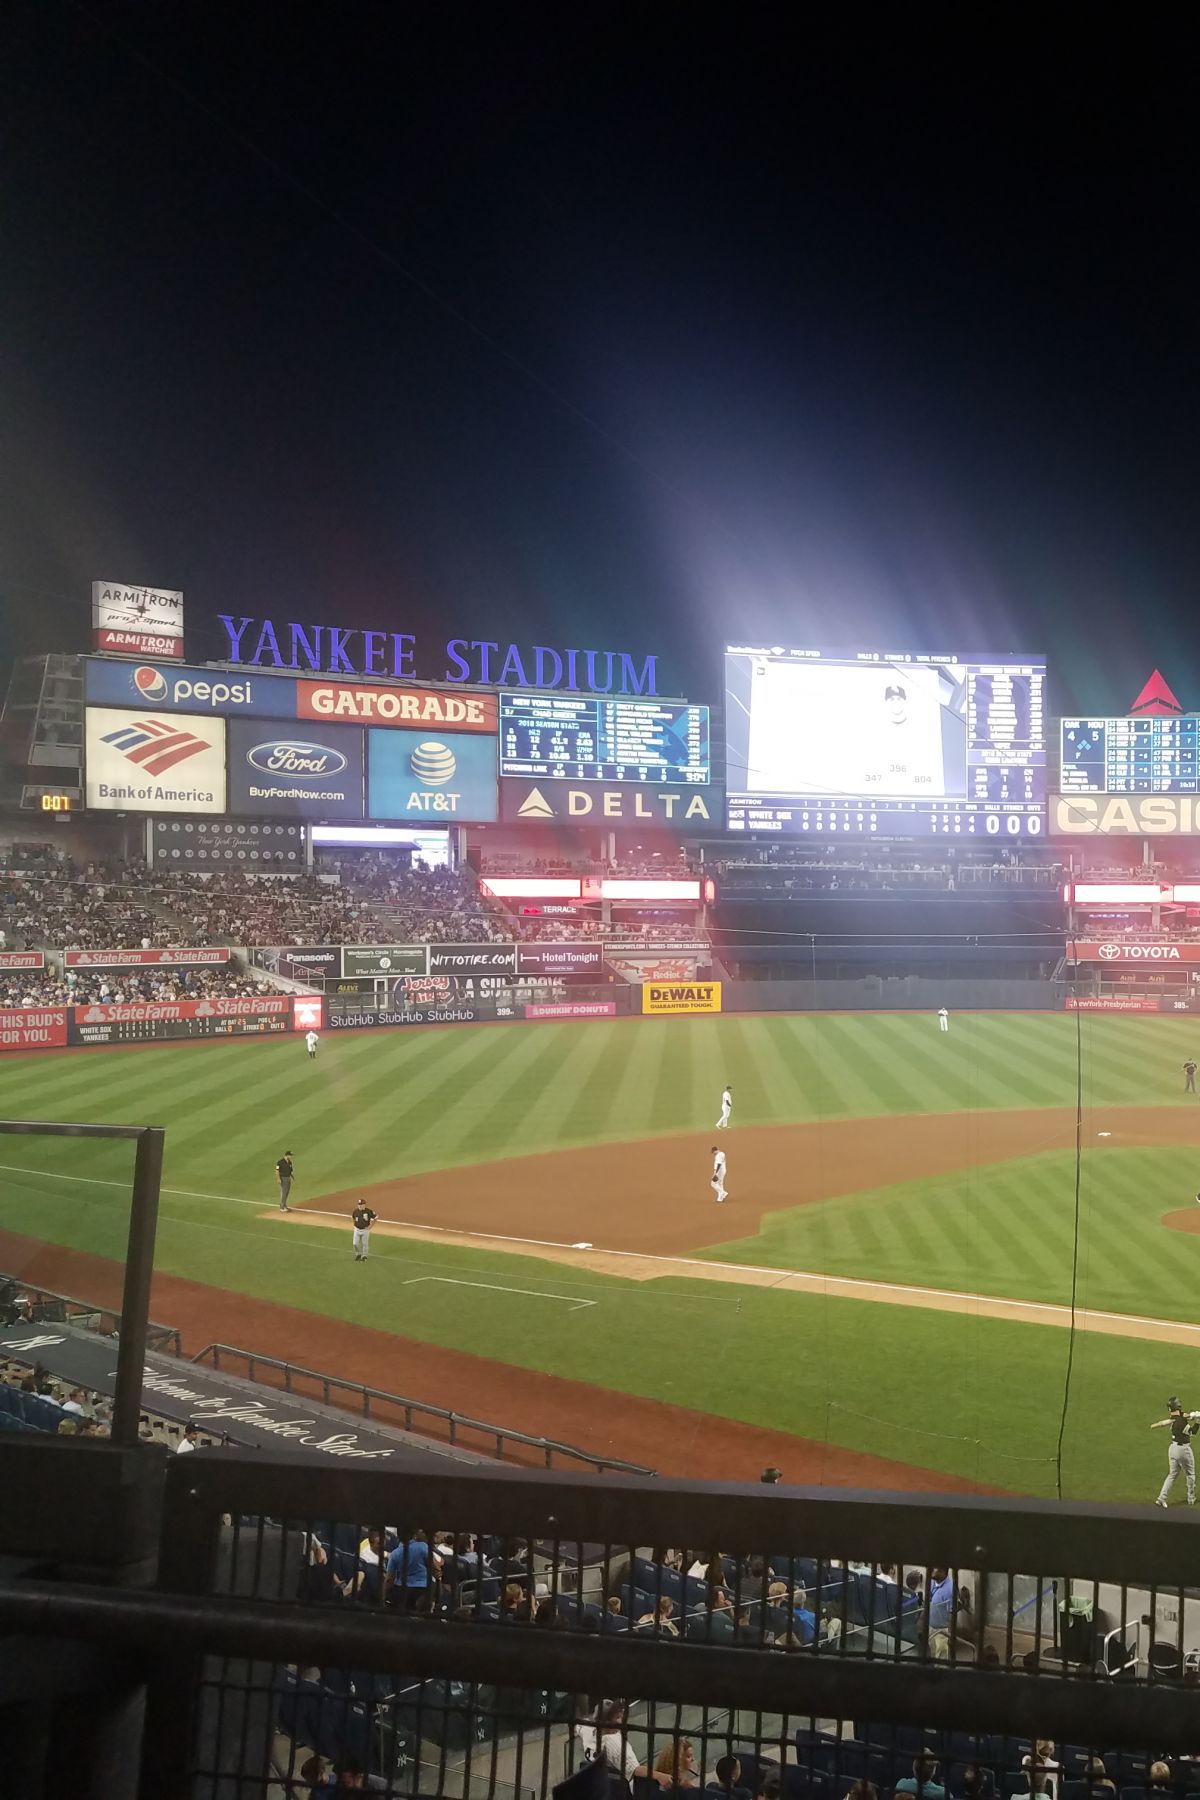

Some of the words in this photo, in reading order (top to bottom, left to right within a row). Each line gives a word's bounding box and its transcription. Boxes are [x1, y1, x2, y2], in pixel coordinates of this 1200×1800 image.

[103, 589, 179, 608] ARMITRON
[106, 633, 175, 648] ARMITRON
[140, 645, 174, 655] WATCHES
[217, 614, 416, 678] YANKEE
[446, 639, 659, 697] STADIUM
[174, 680, 252, 706] pepsi
[311, 689, 485, 724] GATORADE
[1067, 731, 1076, 741] 4
[1092, 731, 1099, 741] 5
[267, 746, 327, 773] Ford
[99, 784, 136, 800] Bank
[137, 785, 153, 800] of
[155, 785, 214, 802] America
[249, 787, 345, 800] BuyFordNow.com
[406, 792, 461, 812] AT&T
[568, 790, 711, 819] DELTA
[986, 815, 999, 835] 0
[1007, 815, 1020, 835] 0
[1027, 815, 1040, 835] 0
[543, 906, 577, 914] TERRACE
[287, 953, 335, 962] Panasonic
[542, 951, 599, 963] HotelTonight
[1122, 946, 1180, 959] TOYOTA
[430, 953, 515, 966] NITTOTIRE.COM
[573, 1005, 609, 1014] DONUTS
[27, 1013, 64, 1027] BUD'S
[331, 1015, 374, 1027] StubHub
[378, 1012, 423, 1024] StubHub
[427, 1009, 474, 1022] StubHub
[23, 1029, 52, 1042] YOU.
[80, 1026, 99, 1034] WHITE
[100, 1025, 112, 1033] SOX
[83, 1033, 109, 1041] YANKEES
